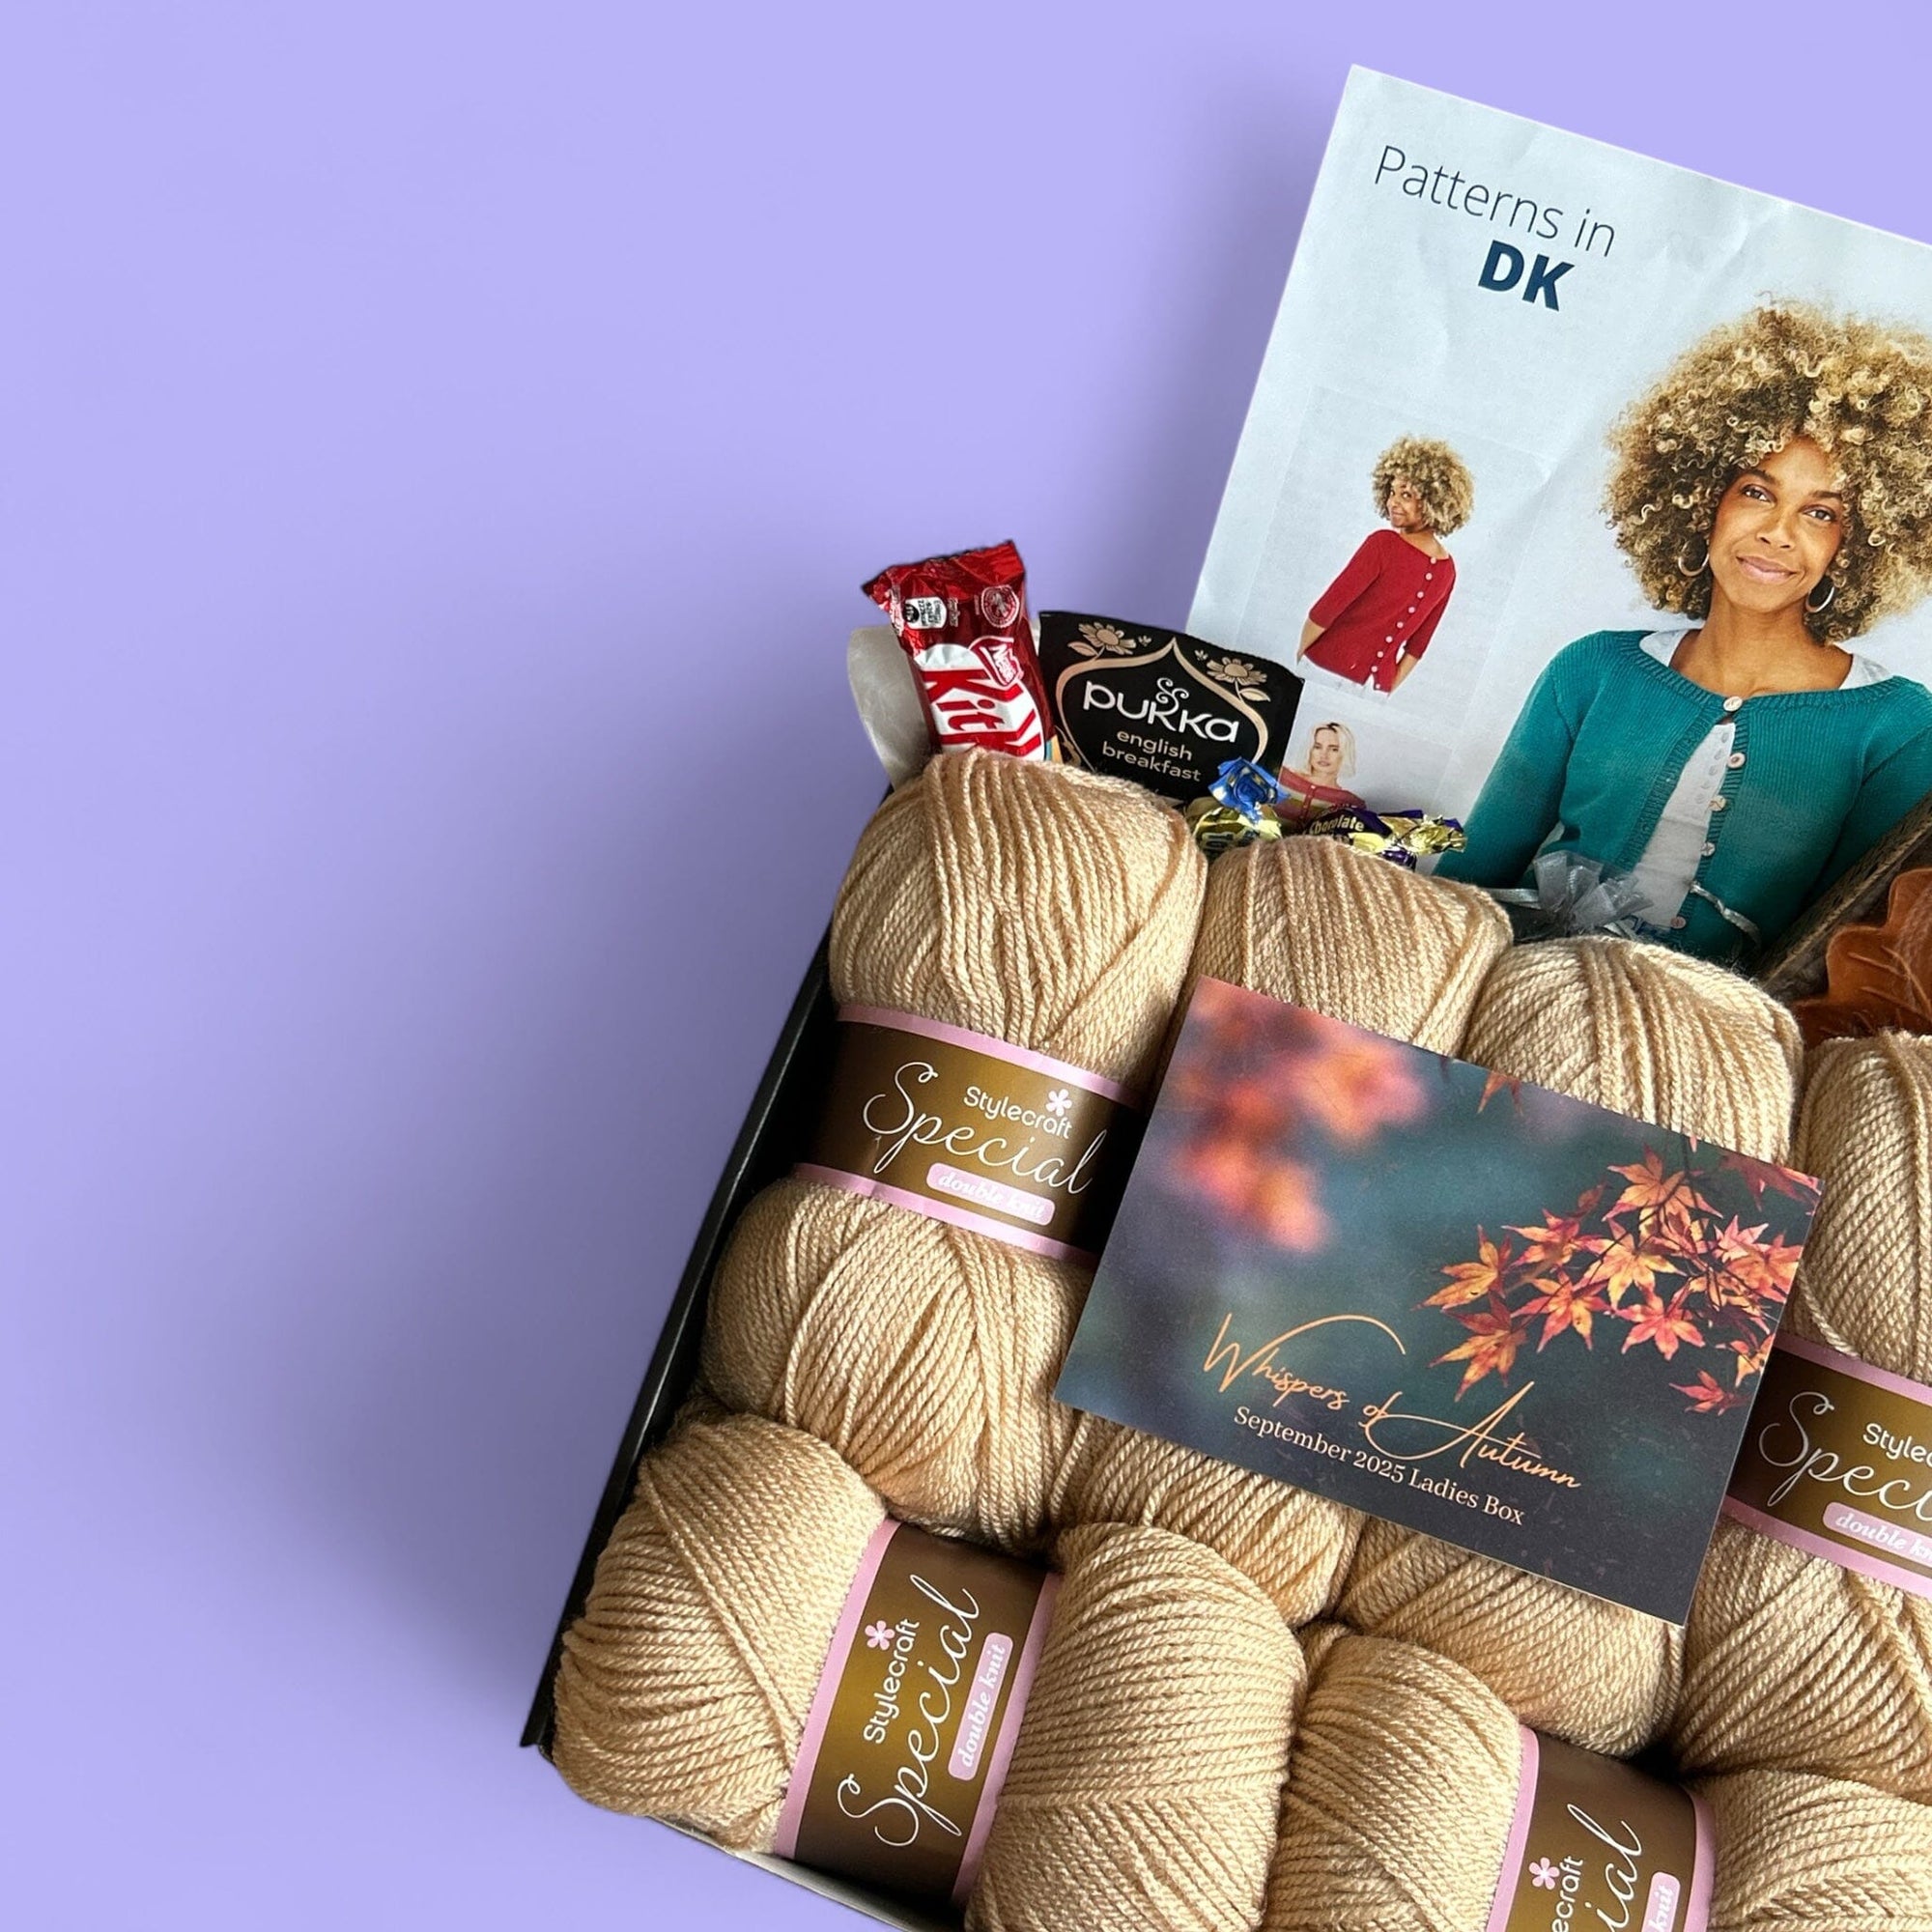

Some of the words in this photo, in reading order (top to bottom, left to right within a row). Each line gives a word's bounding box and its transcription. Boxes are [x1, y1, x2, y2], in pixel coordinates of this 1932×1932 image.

[1375, 145, 1564, 240] Patterns
[1575, 208, 1616, 258] in
[1478, 239, 1576, 312] DK
[1101, 741, 1202, 782] breakfast
[1116, 730, 1193, 762] english
[863, 1061, 1108, 1194] Special
[963, 1086, 1073, 1140] Stylecraft
[938, 1171, 1004, 1205] double
[1204, 1312, 1406, 1411] Whispers
[1358, 1391, 1404, 1432] of
[1365, 1380, 1582, 1490] Autumn
[1234, 1406, 1352, 1463] September
[1352, 1450, 1406, 1485] 2025
[1408, 1469, 1478, 1509] Ladies
[1484, 1496, 1526, 1526] Box
[1836, 1512, 1908, 1550] double
[838, 1574, 980, 1847] Special
[864, 1617, 921, 1745] Stylecraft
[957, 1691, 991, 1768] double
[978, 1643, 1006, 1690] knit
[1647, 1884, 1675, 1932] knit
